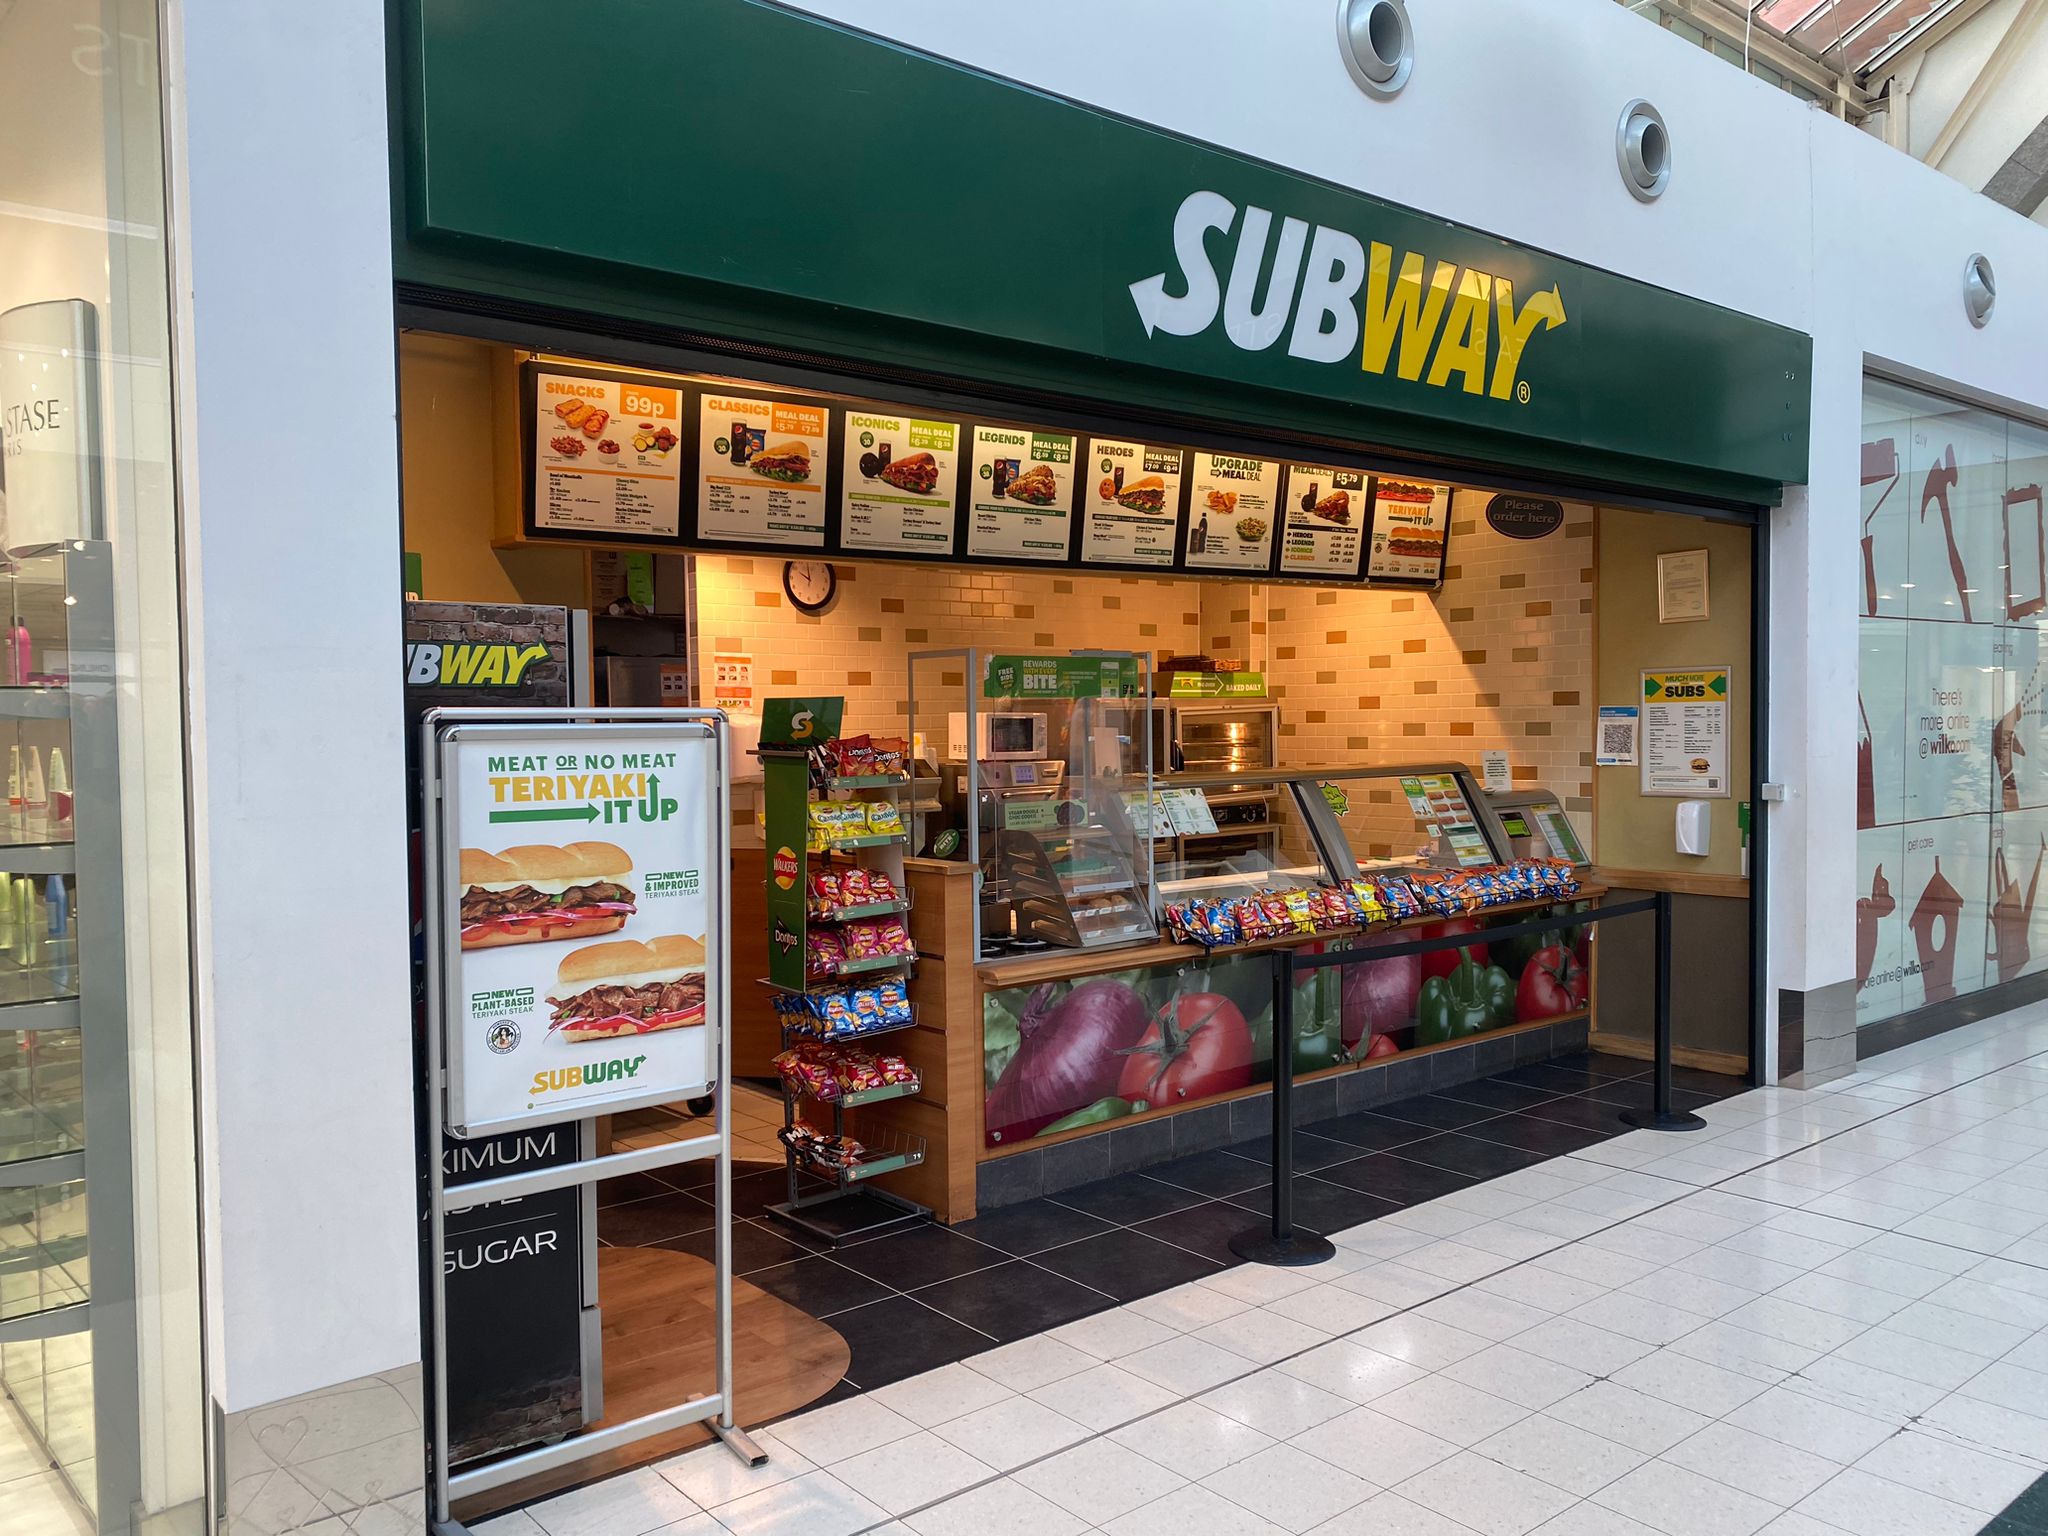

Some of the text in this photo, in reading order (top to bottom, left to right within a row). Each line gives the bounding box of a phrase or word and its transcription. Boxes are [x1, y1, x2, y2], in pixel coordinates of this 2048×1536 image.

[1129, 190, 1567, 401] SUBWAY
[545, 382, 605, 399] SNACKS
[626, 395, 664, 416] 99p
[708, 400, 770, 416] CLASSICS
[775, 410, 819, 422] MEAL DEAL
[852, 416, 900, 431] ICONICS
[911, 427, 952, 438] MEAL DEAL
[979, 431, 1026, 446] LEGENDS
[1033, 440, 1070, 452] MEAL DEAL
[1097, 445, 1134, 457] HEROES
[1145, 453, 1179, 463] MEAL DEAL
[1211, 455, 1263, 472] UPGRADE
[1222, 469, 1261, 481] MEAL DEAL
[1336, 473, 1358, 485] £5.79
[1388, 504, 1426, 516] TERIYAKI
[1505, 500, 1544, 511] Please
[1414, 516, 1434, 526] IT UP
[1493, 512, 1555, 523] order here
[1023, 660, 1057, 668] REWARDS
[998, 667, 1014, 676] FREE
[1023, 674, 1057, 689] BITE
[1665, 675, 1689, 683] MUCH
[1664, 685, 1705, 698] SUBS
[1931, 687, 1963, 706] There's
[1920, 713, 1970, 731] more online
[488, 753, 676, 772] MEAT OR NO MEAT
[873, 751, 900, 762] Doritos
[489, 773, 646, 802] TERIYAKI
[604, 798, 678, 824] IT UP
[1907, 838, 1935, 853] pet care
[773, 858, 798, 874] WALKERS
[663, 871, 684, 880] NEW
[645, 879, 699, 891] & IMPROVED
[645, 889, 699, 899] TERIYAKI STEAK
[775, 929, 797, 946] Doritos
[1876, 969, 1895, 986] online
[492, 989, 515, 999] NEW
[472, 997, 534, 1011] PLANT-BASED
[472, 1006, 533, 1019] TERIYAKI STEAK
[528, 1054, 647, 1096] SUBWAY
